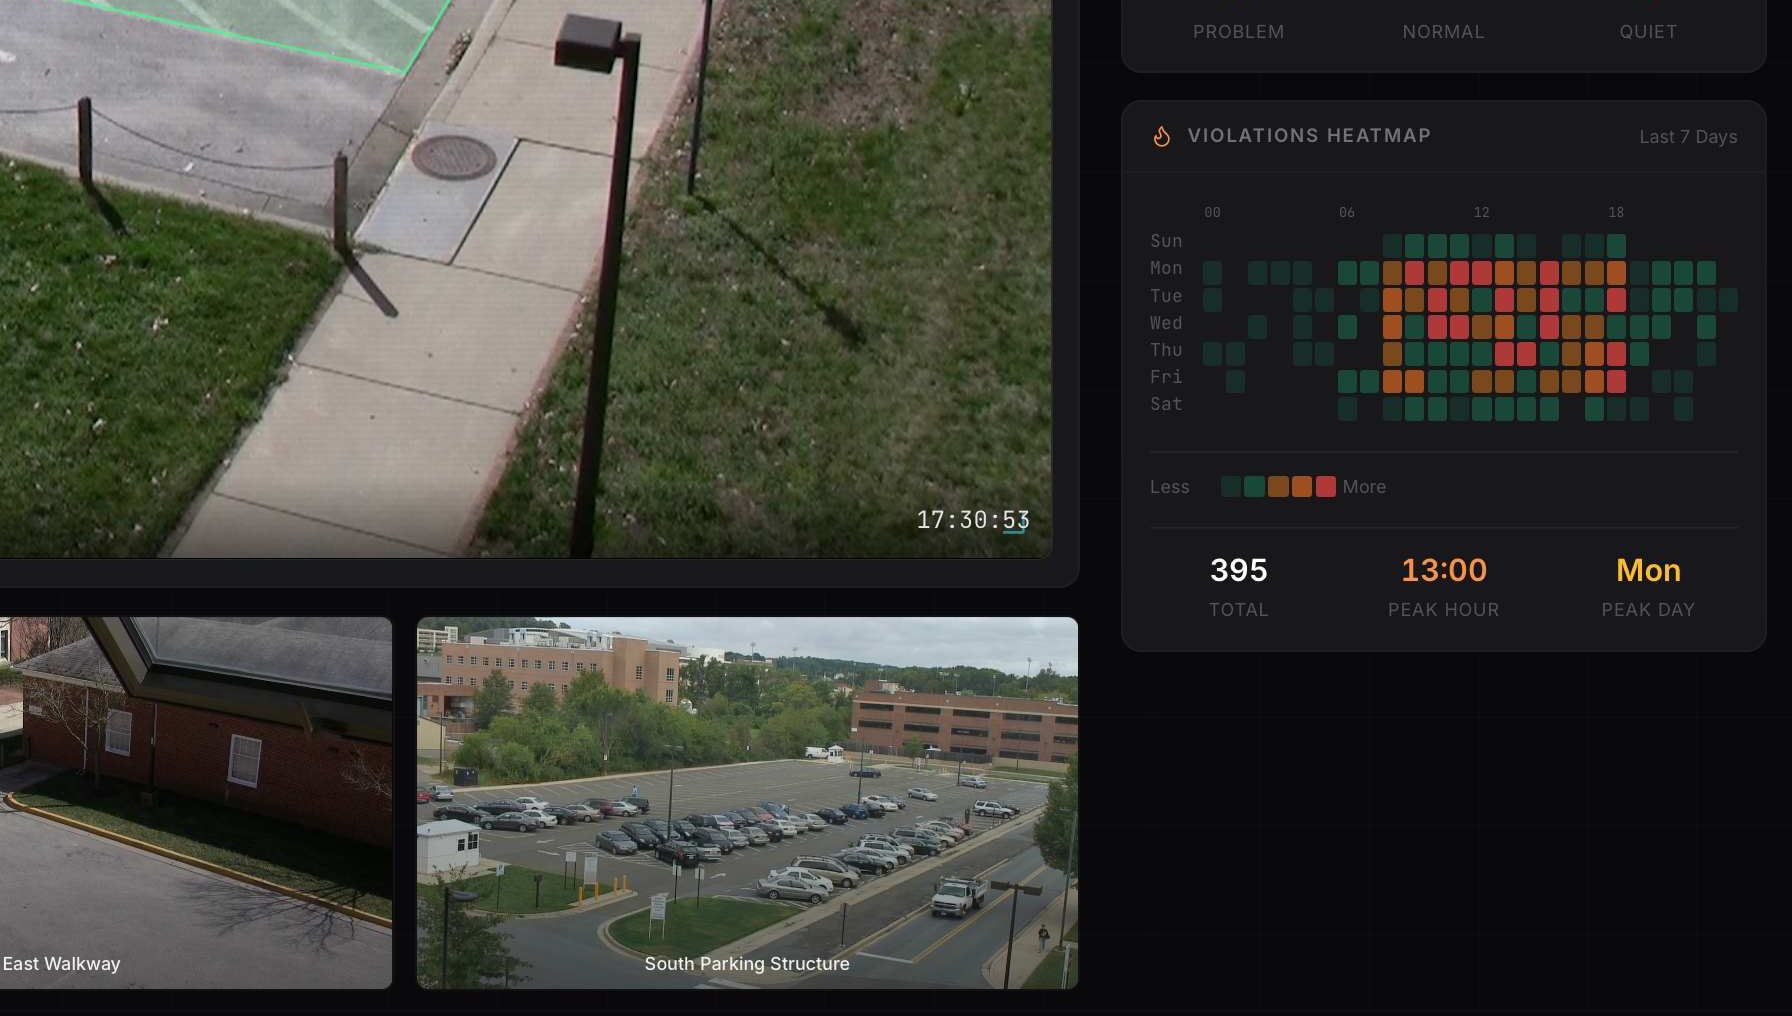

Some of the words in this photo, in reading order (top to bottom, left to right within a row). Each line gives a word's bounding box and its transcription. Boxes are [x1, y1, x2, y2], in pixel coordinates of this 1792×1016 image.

[1193, 23, 1284, 40] PROBLEM
[1403, 23, 1485, 39] NORMAL
[1619, 23, 1678, 40] QUIET
[1187, 127, 1318, 143] VIOLATIONS
[1327, 127, 1431, 143] HEATMAP
[1640, 129, 1676, 144] Last
[1679, 129, 1690, 145] 7
[1696, 129, 1738, 148] Days
[1204, 206, 1221, 218] 00
[1339, 206, 1355, 218] 06
[1474, 206, 1490, 219] 12
[1608, 206, 1624, 218] 18
[1151, 233, 1182, 249] Sun
[1150, 260, 1182, 275] Mon
[1150, 288, 1182, 304] Tue
[1149, 315, 1182, 330] Wed
[1150, 342, 1182, 357] Thu
[1151, 368, 1183, 385] Fri
[1151, 396, 1183, 413] Sat
[1150, 479, 1190, 495] Less
[1343, 479, 1387, 494] More
[1210, 557, 1268, 583] 395
[1402, 557, 1487, 582] 13:00
[1617, 557, 1681, 582] Mon
[1207, 602, 1269, 617] TOTAL
[1388, 602, 1438, 617] PEAK
[1445, 602, 1499, 617] HOUR
[1602, 602, 1651, 617] PEAK
[1658, 600, 1695, 617] DAY
